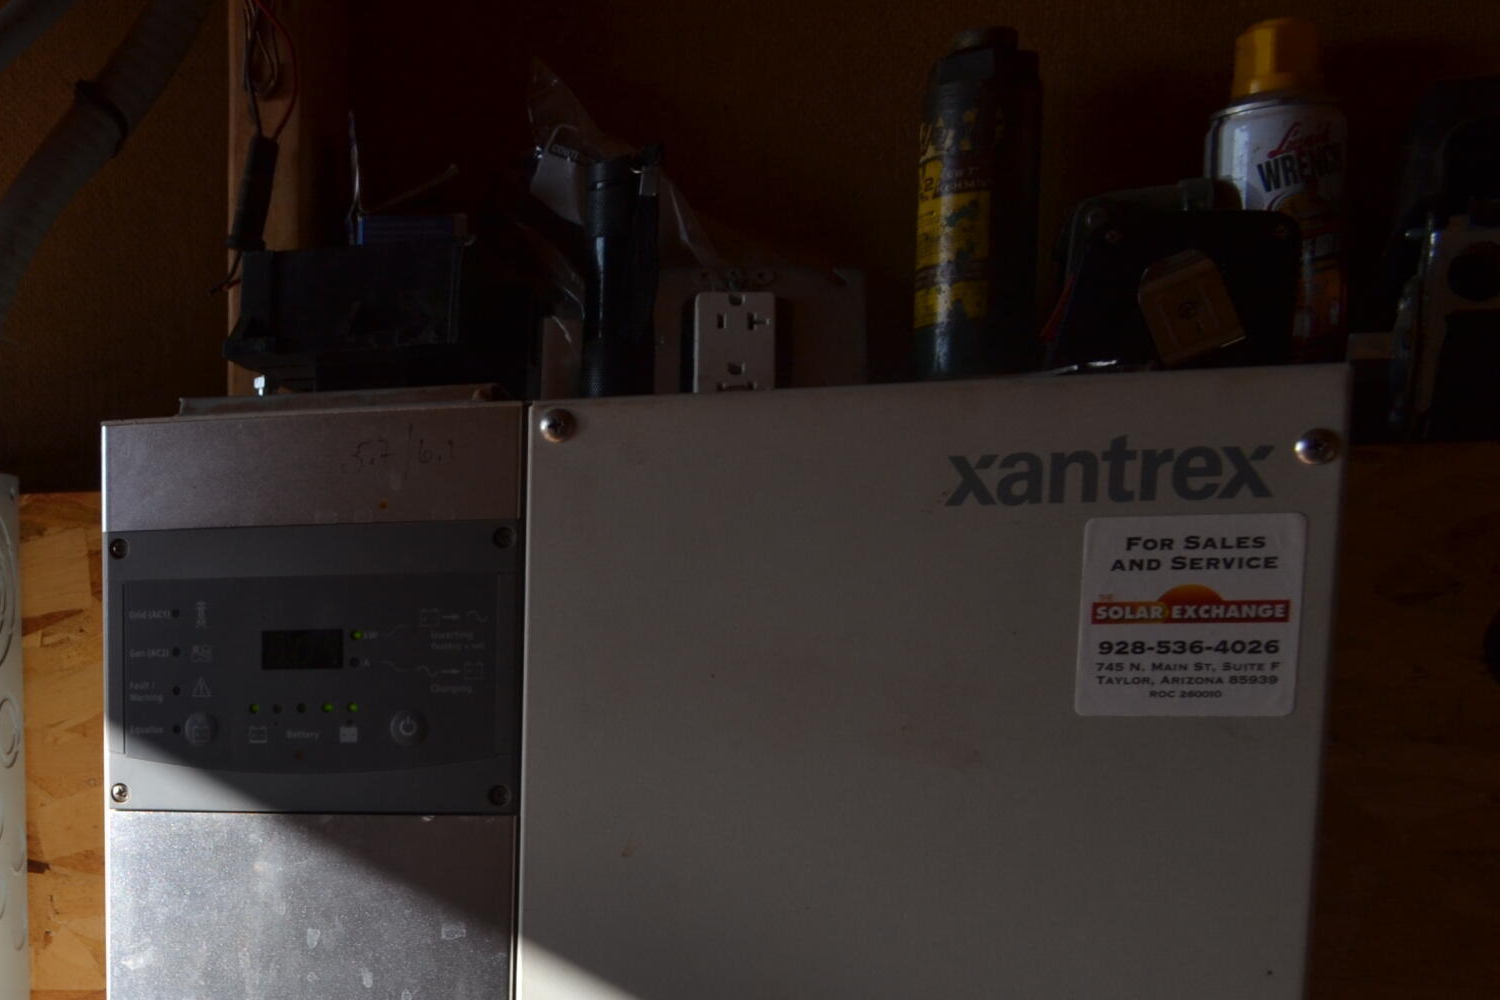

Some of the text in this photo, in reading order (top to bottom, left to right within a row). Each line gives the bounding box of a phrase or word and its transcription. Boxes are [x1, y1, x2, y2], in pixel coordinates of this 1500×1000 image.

[945, 435, 1273, 506] xantrex
[1110, 558, 1161, 571] AND
[1095, 603, 1286, 619] SOLAR EXCHANGE
[1097, 640, 1280, 655] 928-536-4026
[1095, 662, 1124, 672] 745
[1129, 662, 1146, 672] N.
[1270, 662, 1282, 671] F
[1228, 675, 1279, 685] 85939
[285, 729, 320, 742] Battery
